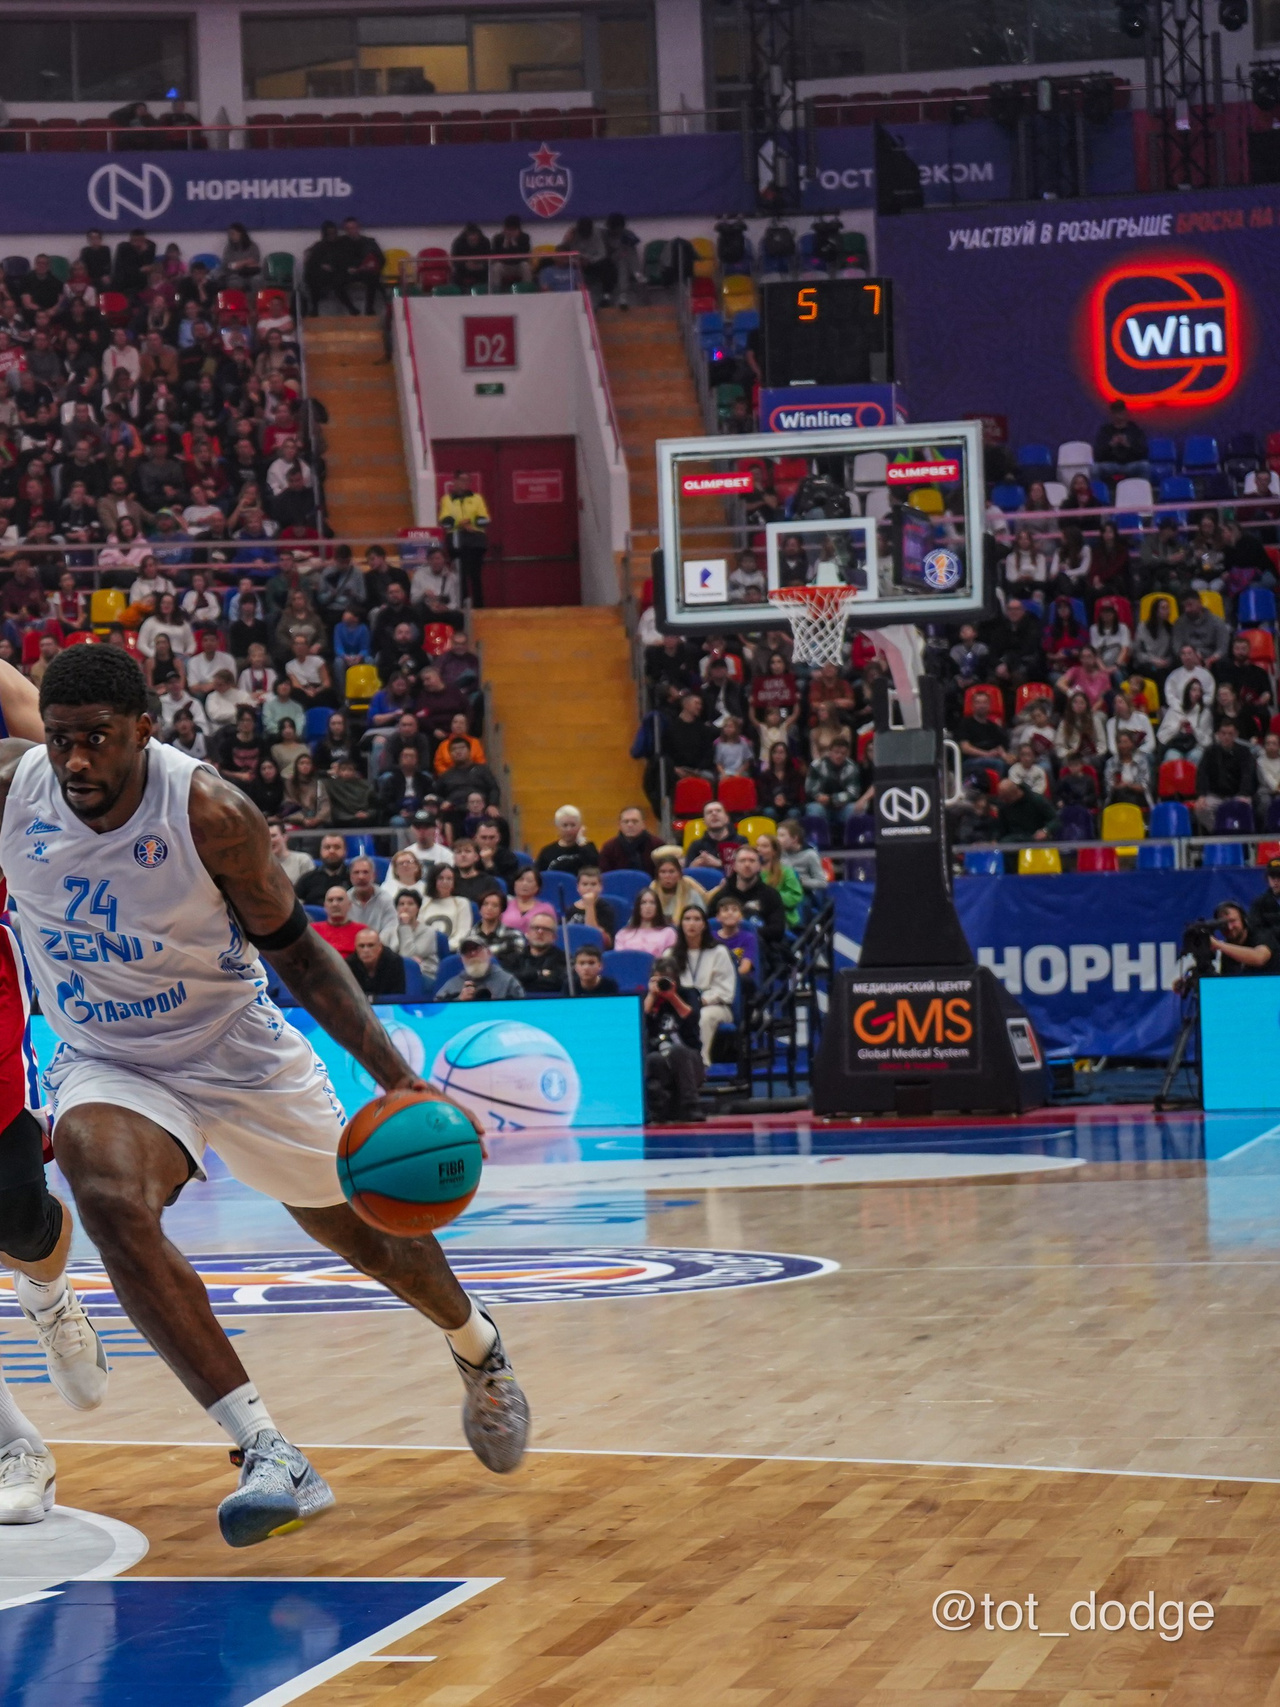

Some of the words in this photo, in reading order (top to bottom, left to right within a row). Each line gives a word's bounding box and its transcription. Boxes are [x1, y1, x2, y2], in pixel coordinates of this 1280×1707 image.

[186, 177, 353, 200] НОРНИКЕЛЬ
[524, 173, 565, 189] ЦСКА
[948, 220, 1036, 251] УЧАСТВУЙ
[1040, 222, 1053, 245] В
[1057, 214, 1173, 243] РОЗЫГРЫШЕ
[797, 288, 818, 320] 5
[863, 284, 881, 315] 7
[1125, 315, 1223, 356] Win
[474, 335, 507, 363] D2
[779, 411, 853, 429] Winline
[888, 464, 956, 479] OLIMPBET
[684, 477, 750, 491] OLIMPBET
[40, 926, 164, 962] ZENI
[852, 980, 935, 995] МЕДИЦИНСКИЙ
[937, 980, 972, 994] ЦЕНТР
[853, 998, 973, 1045] GMS
[858, 1048, 890, 1060] Global
[891, 1047, 931, 1059] Medical
[933, 1047, 969, 1060] System
